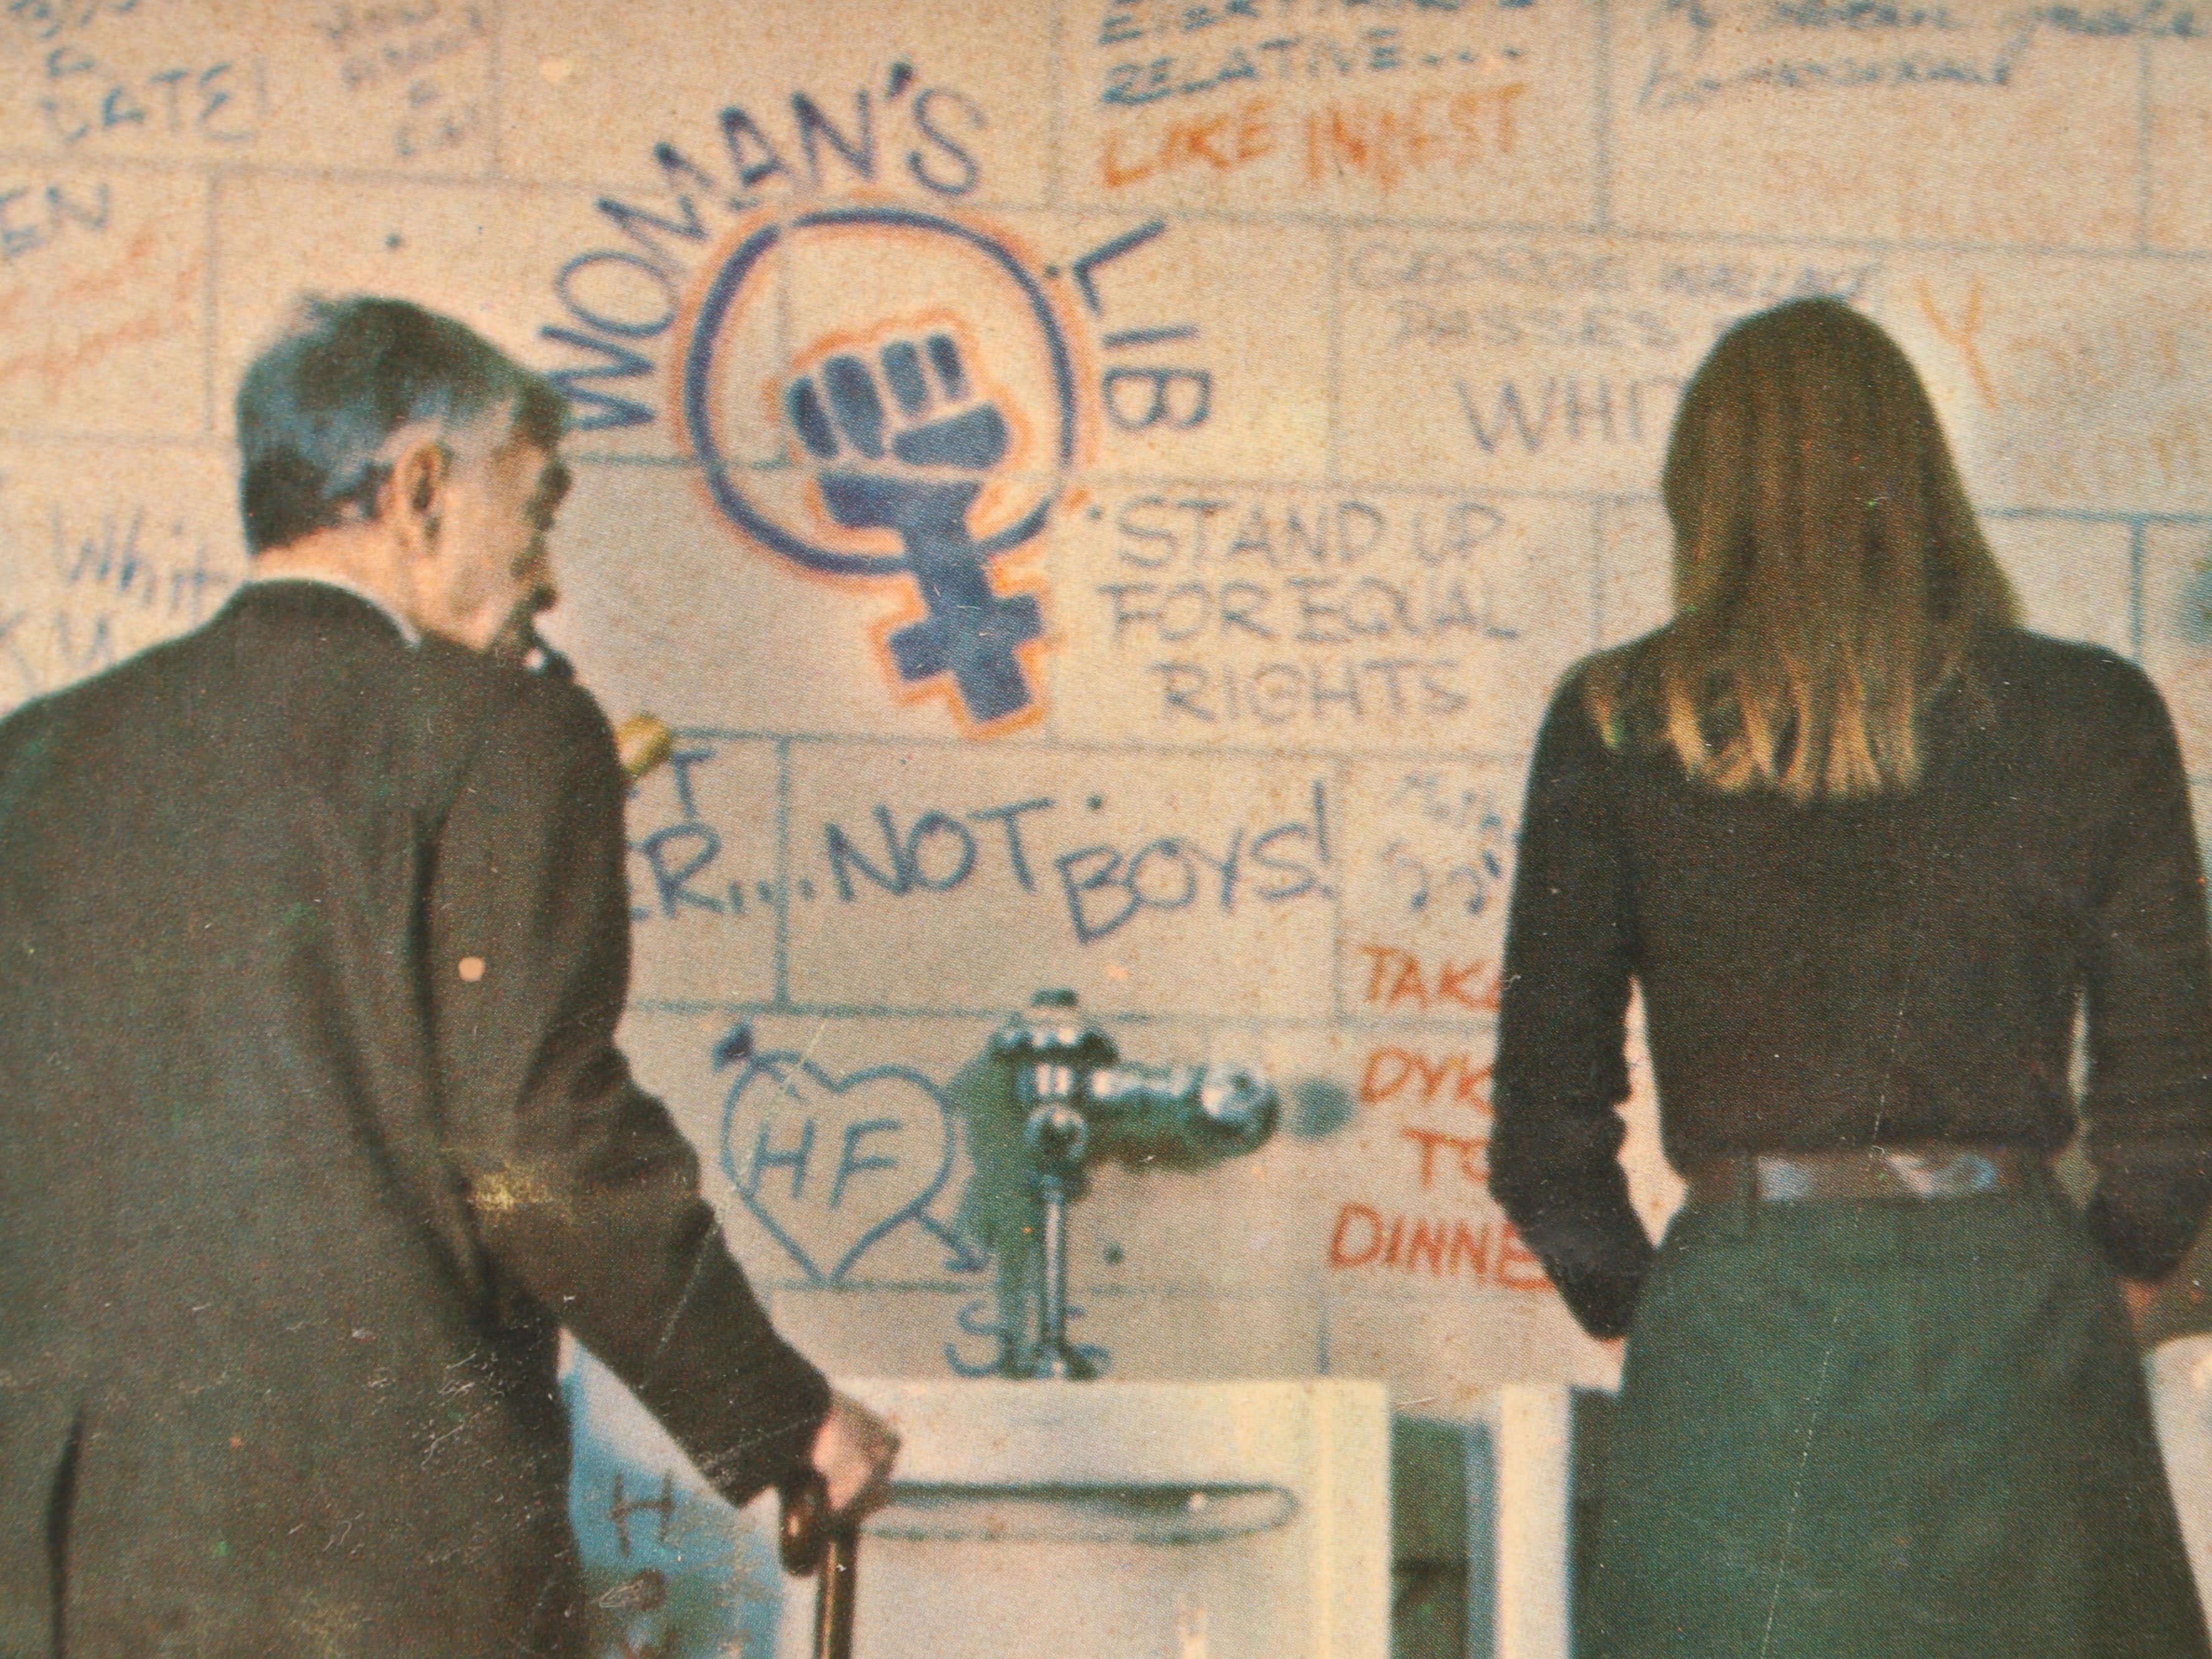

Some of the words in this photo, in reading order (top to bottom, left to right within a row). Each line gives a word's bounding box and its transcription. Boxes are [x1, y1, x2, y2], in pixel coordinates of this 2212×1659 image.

[1072, 218, 1213, 433] LIB
[1116, 495, 1389, 570] STAND
[1412, 499, 1507, 567] UP
[1097, 580, 1278, 645] FOR
[1284, 574, 1521, 645] EQUAL
[1147, 657, 1470, 726] RIGHTS
[823, 794, 1060, 904] NOT
[1054, 778, 1334, 945] BOYS!
[1360, 1046, 1497, 1117] DYK
[1329, 1201, 1554, 1293] DINNE
